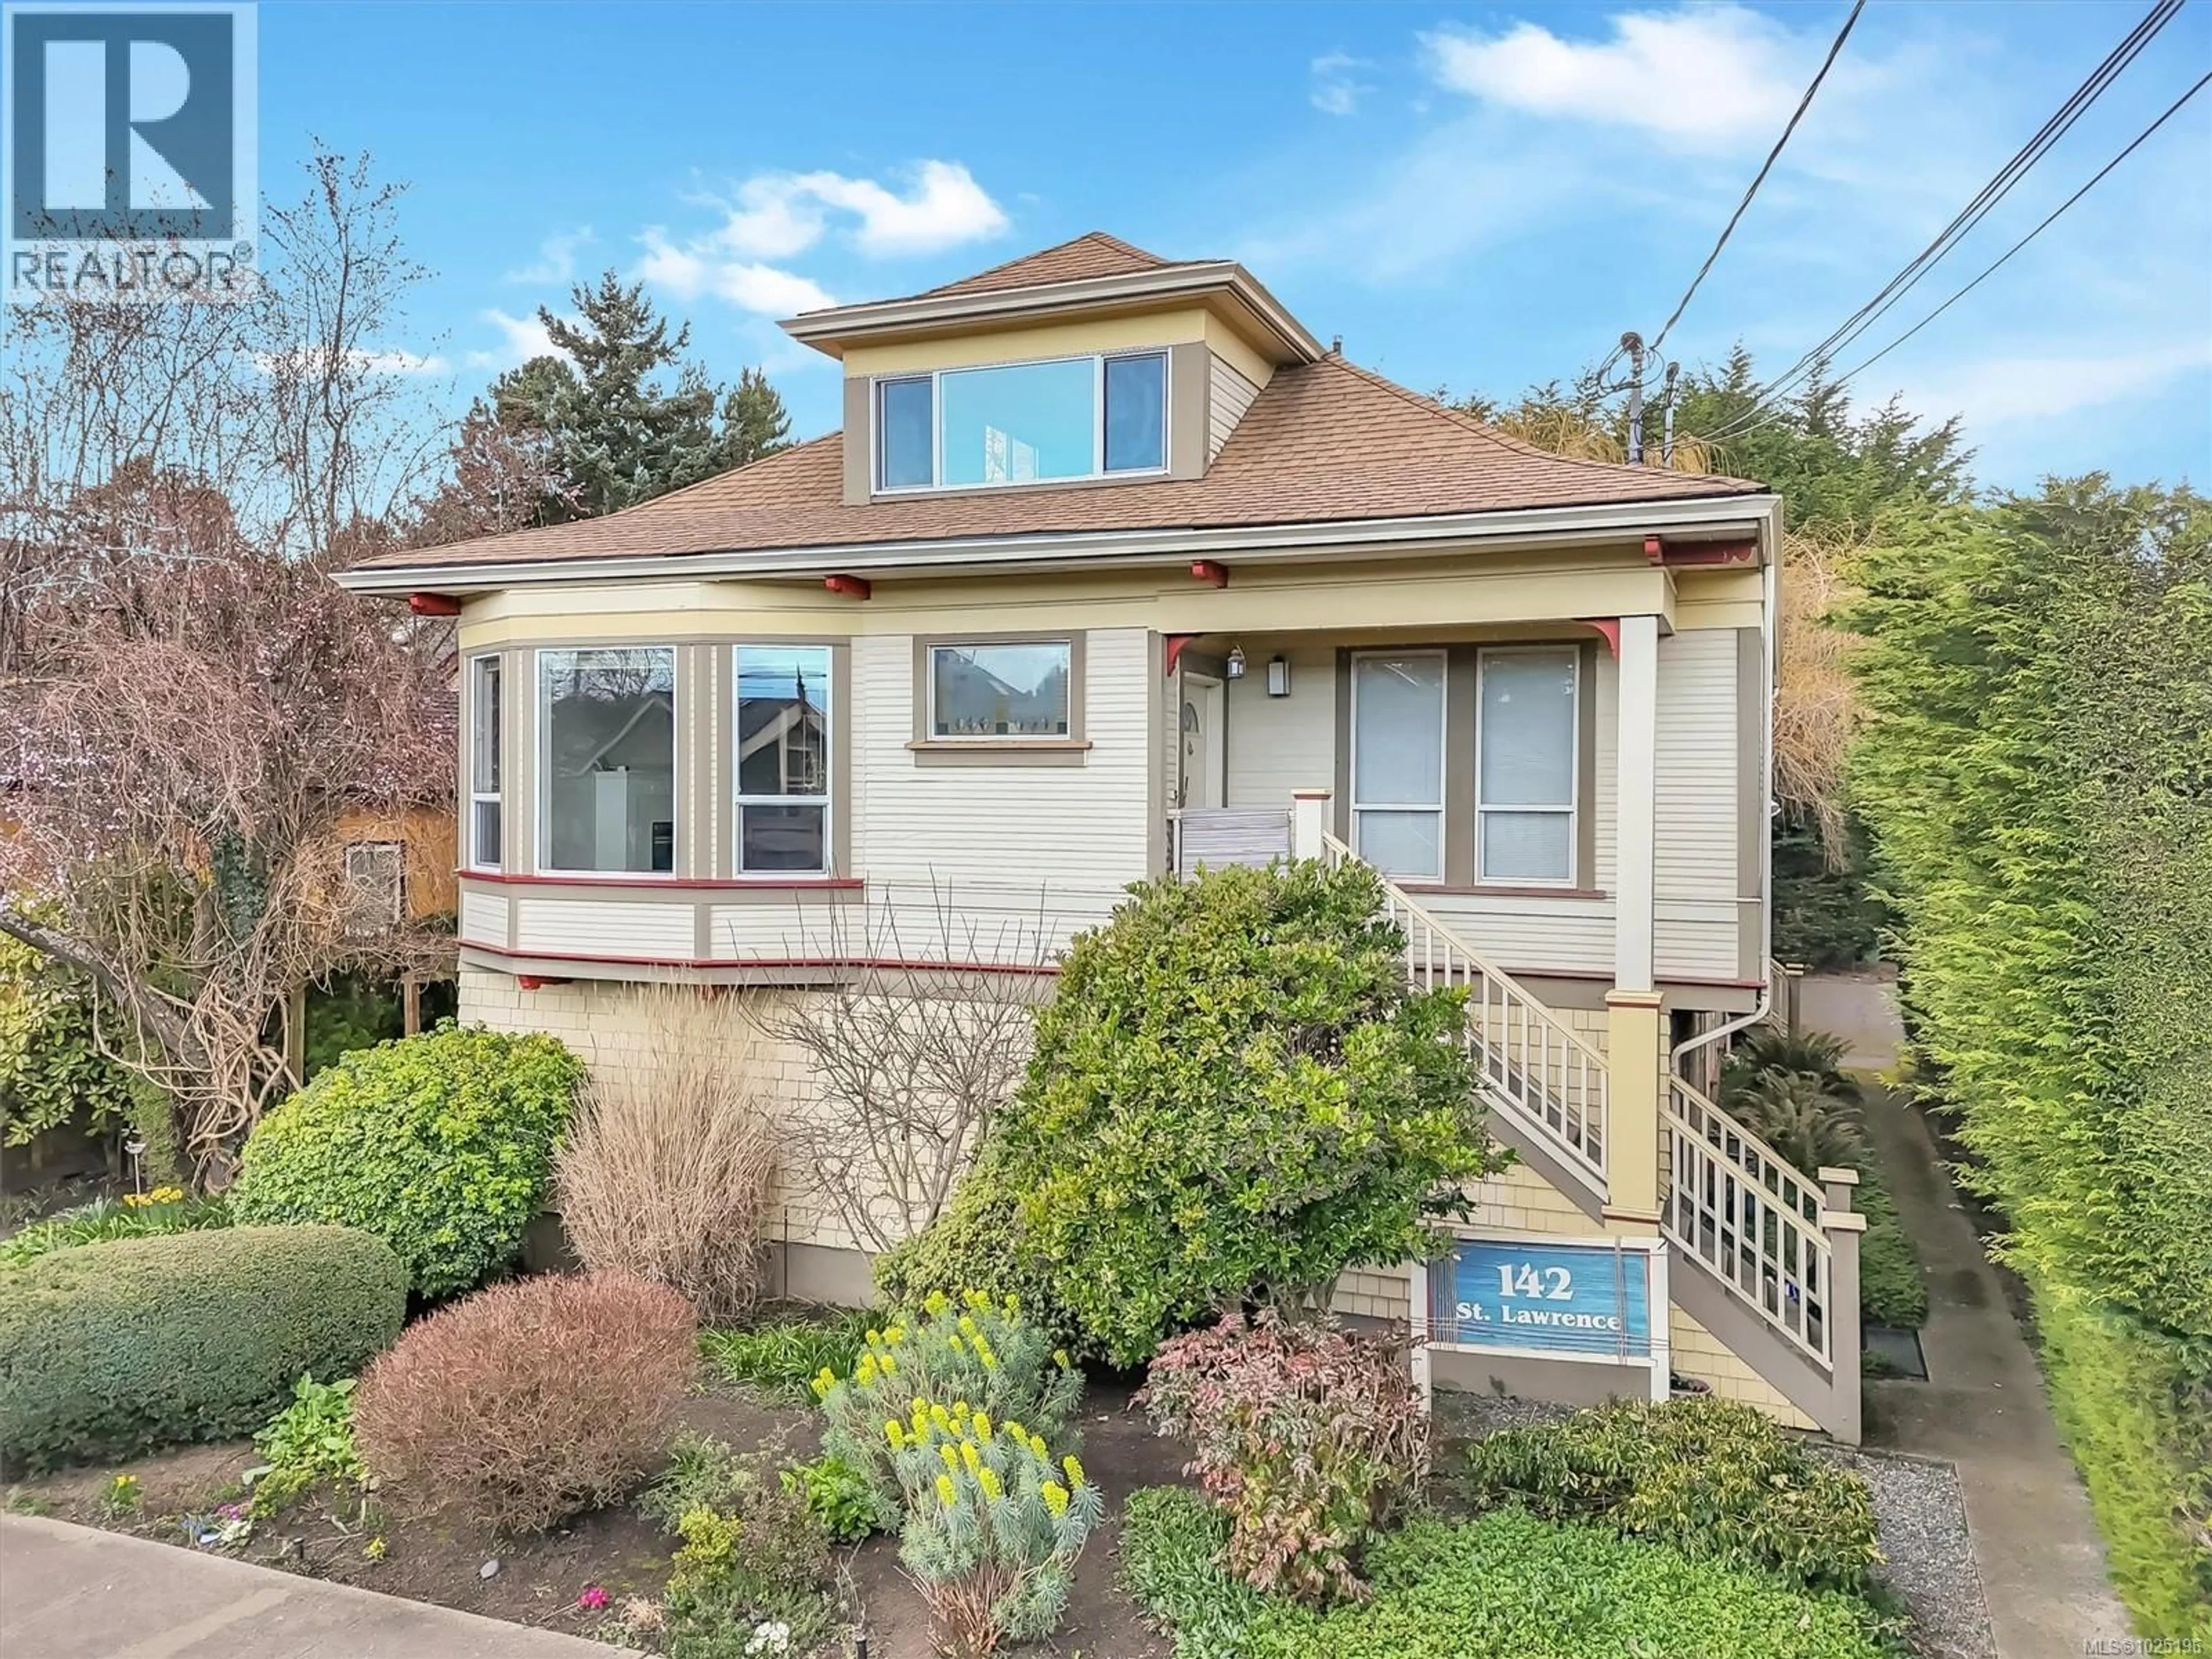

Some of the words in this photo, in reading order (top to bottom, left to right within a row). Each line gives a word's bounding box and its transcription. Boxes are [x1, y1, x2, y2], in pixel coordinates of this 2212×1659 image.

[1498, 1263, 1573, 1300] 142
[1456, 1302, 1490, 1321] St.
[1502, 1305, 1621, 1331] Lawrence
